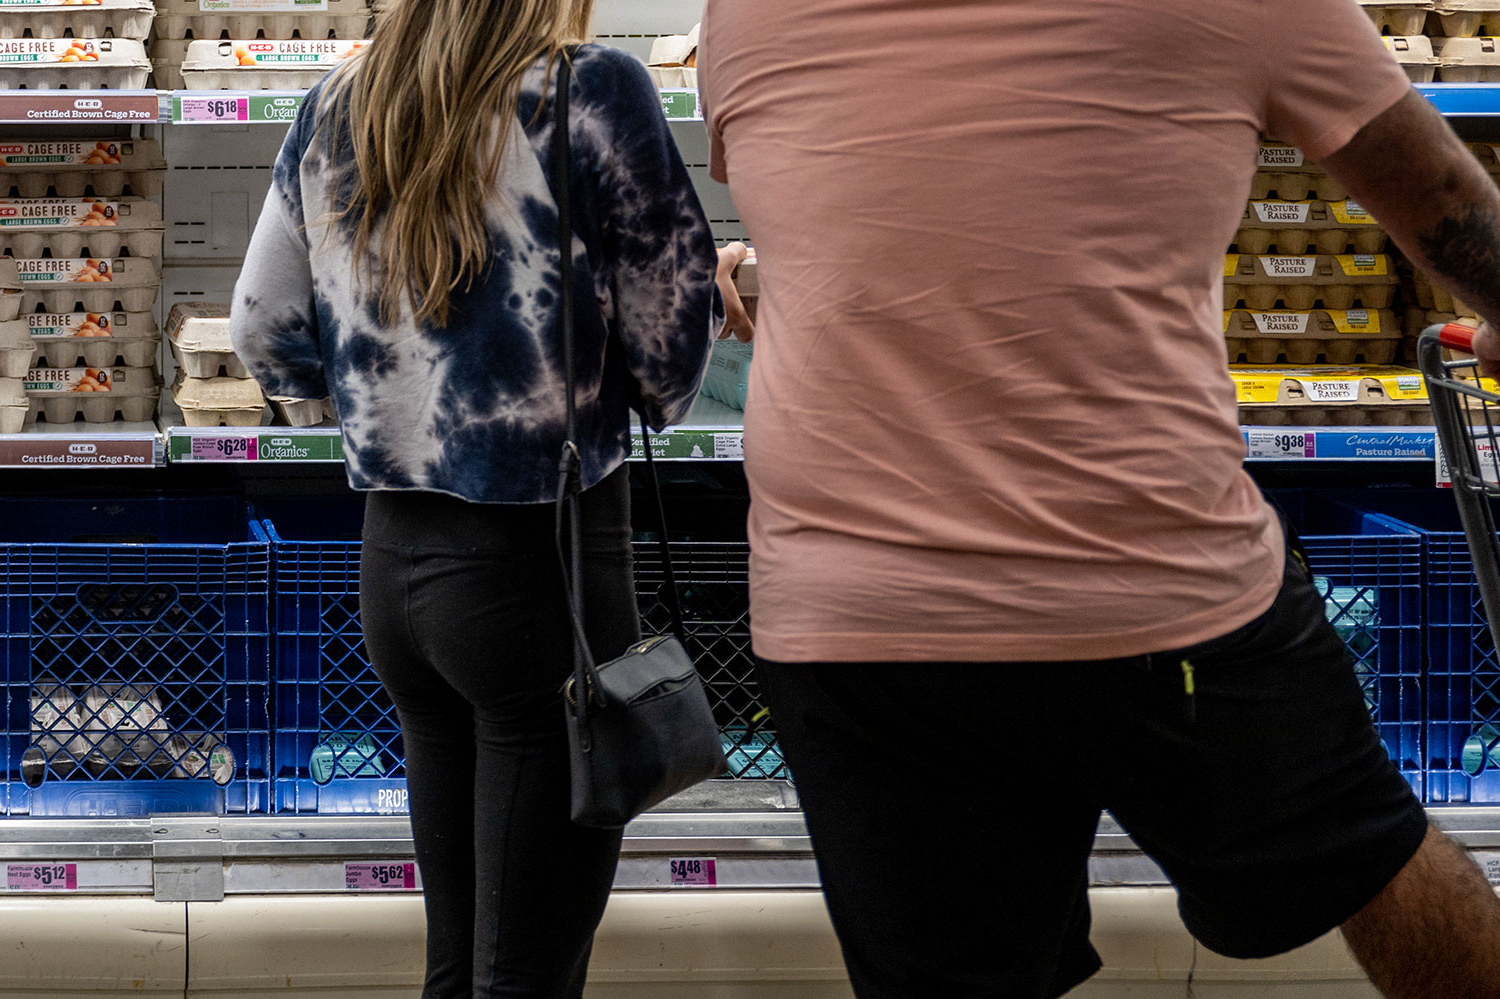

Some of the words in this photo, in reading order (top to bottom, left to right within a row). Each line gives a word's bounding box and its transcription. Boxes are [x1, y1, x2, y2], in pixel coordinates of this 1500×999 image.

[29, 42, 55, 52] FREE
[279, 43, 306, 53] CAGE
[310, 43, 336, 53] FREE
[27, 110, 71, 118] Certified
[72, 110, 103, 118] Brown
[104, 110, 128, 119] Cage
[129, 110, 150, 118] Free
[264, 103, 300, 120] Organi
[1260, 148, 1296, 156] PASTURE
[1263, 204, 1299, 212] PASTURE
[1268, 212, 1299, 220] RAISED
[1312, 383, 1350, 391] PASTURE
[261, 443, 308, 460] Organics
[1356, 448, 1392, 456] Pasture
[1394, 448, 1426, 456] Raised
[22, 455, 65, 463] Certified
[66, 455, 97, 463] Brown
[99, 455, 122, 464] Cage
[124, 455, 145, 463] Free
[378, 788, 408, 808] PROP
